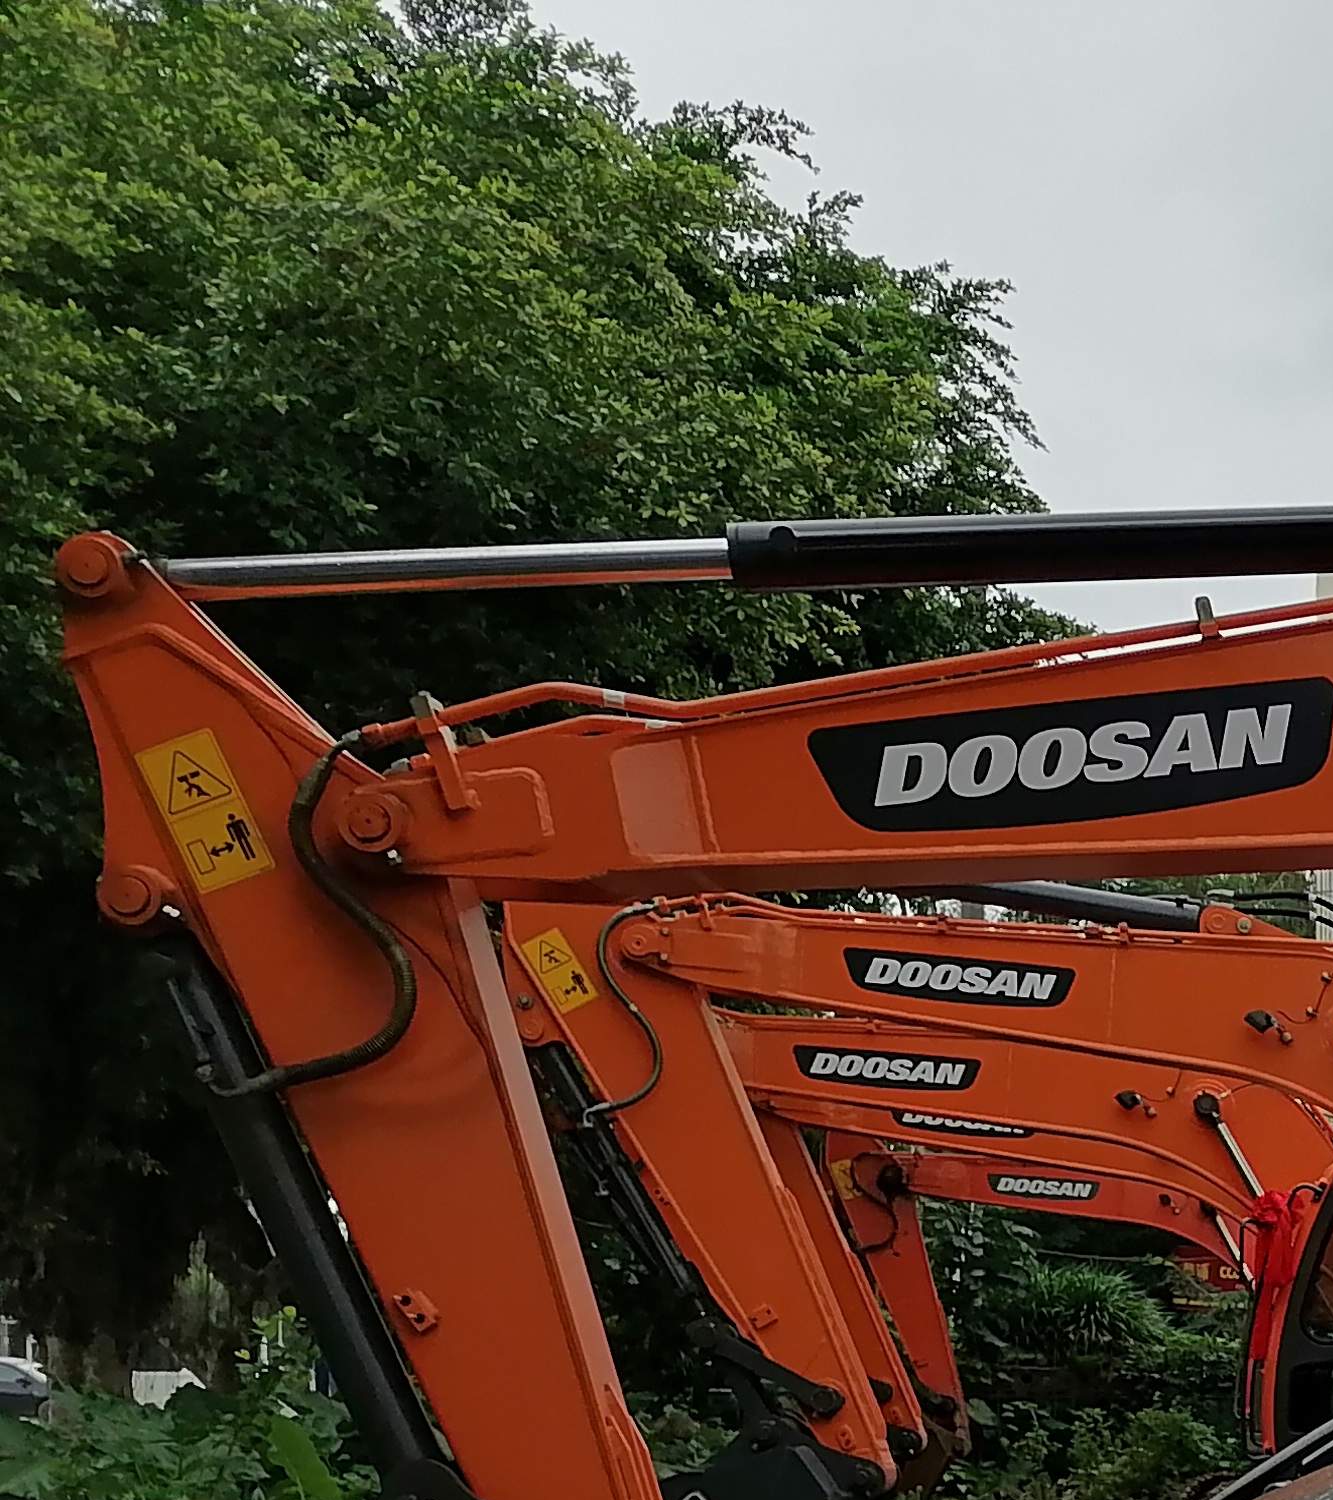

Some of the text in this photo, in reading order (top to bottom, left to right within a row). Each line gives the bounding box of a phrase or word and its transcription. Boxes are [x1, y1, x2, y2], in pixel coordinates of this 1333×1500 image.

[874, 703, 1292, 807] DOOSAN
[864, 956, 1058, 1001] DOOSAN
[809, 1051, 966, 1086] DOOSAN
[996, 1176, 1093, 1199] DOOSAN
